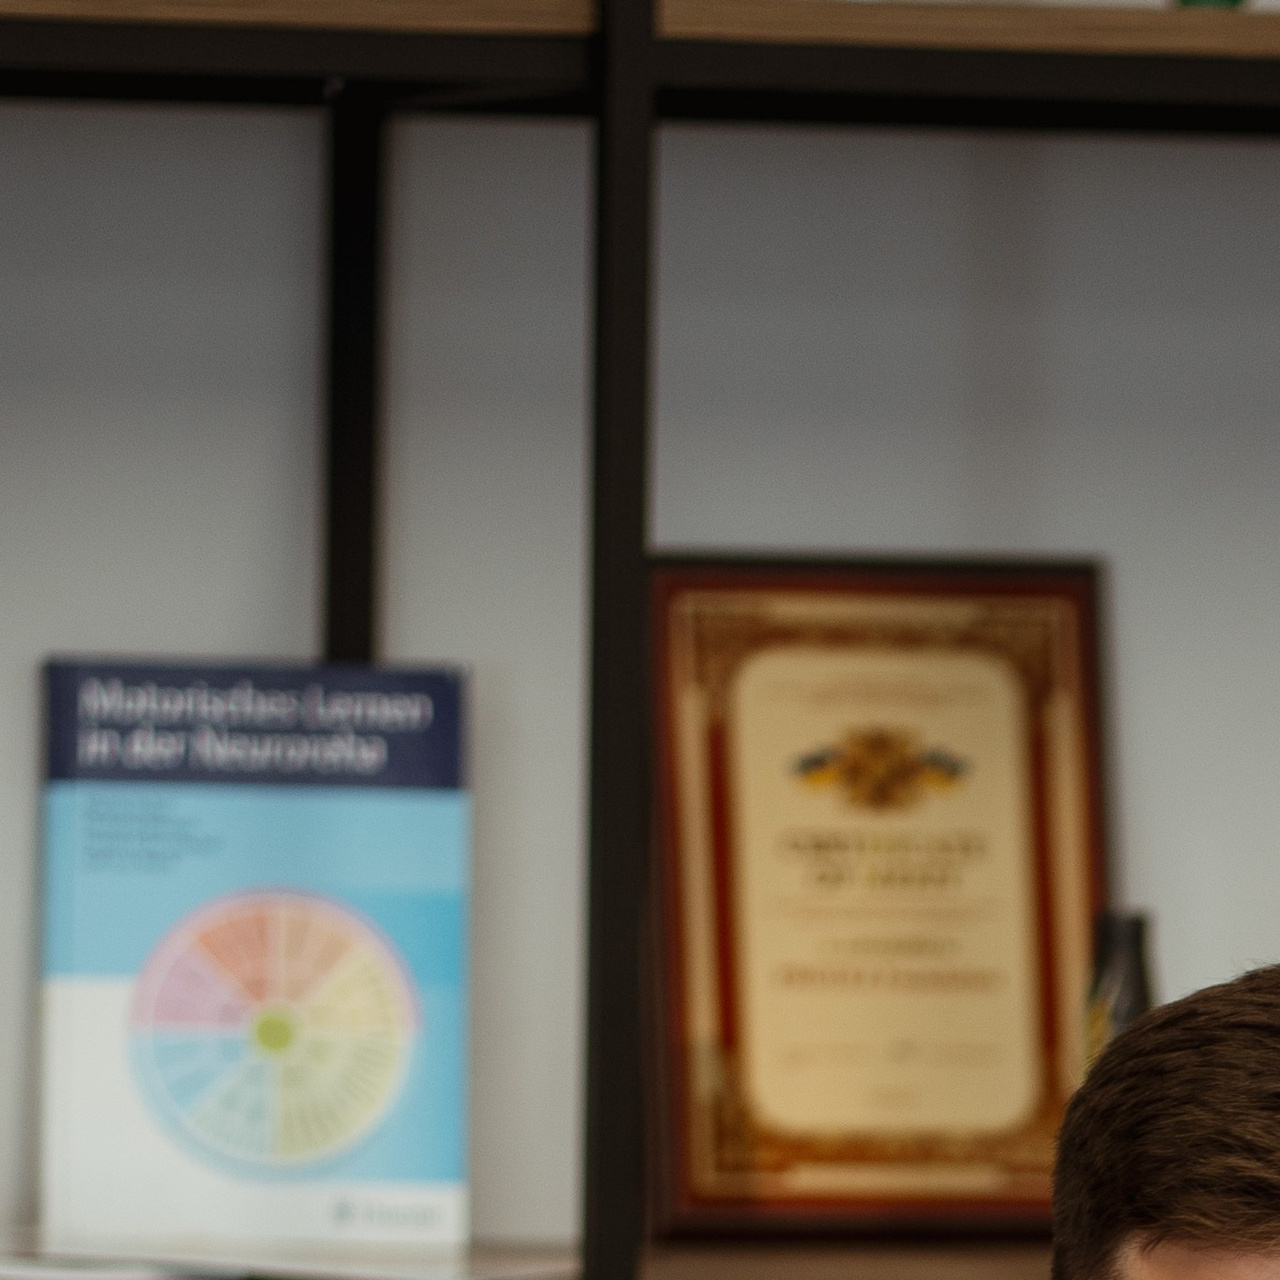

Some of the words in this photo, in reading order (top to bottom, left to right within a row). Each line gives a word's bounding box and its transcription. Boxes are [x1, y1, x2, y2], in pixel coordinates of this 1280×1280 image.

[80, 678, 298, 725] Motorisches
[304, 684, 433, 730] Lernen
[79, 728, 120, 767] in
[123, 726, 187, 769] der
